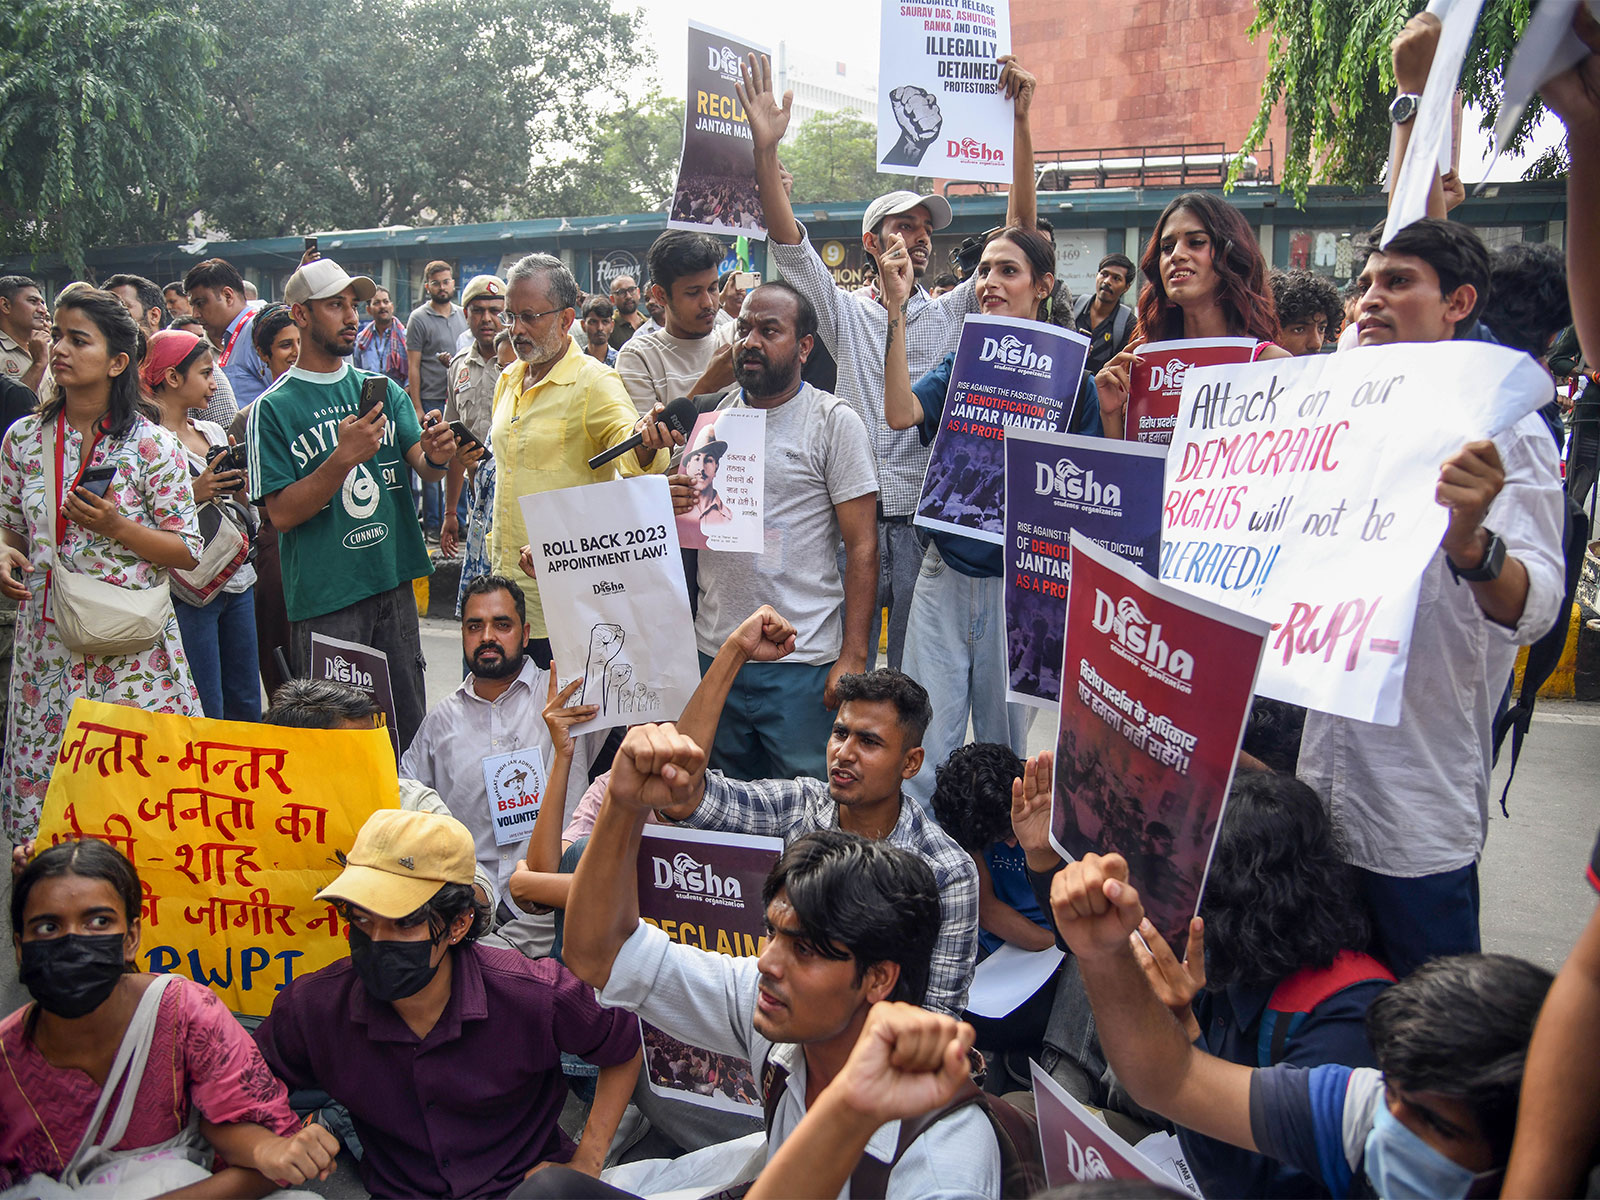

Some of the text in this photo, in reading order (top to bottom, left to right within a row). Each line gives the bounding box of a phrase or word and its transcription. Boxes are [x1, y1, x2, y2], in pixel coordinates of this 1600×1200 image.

[900, 0, 995, 16] IATELY RELEASE
[900, 6, 996, 27] SAURAV DAS, ASHUTOSH
[924, 20, 997, 39] RANKA AND OTHER
[926, 36, 997, 58] ILLEGALLY
[938, 61, 998, 80] DETAINED
[944, 81, 998, 95] PROTESTORS!
[697, 90, 750, 124] RECLA
[696, 118, 731, 135] JANTAR
[734, 124, 752, 140] MAN
[946, 137, 1003, 161] Disha
[827, 245, 839, 261] 9
[830, 269, 862, 283] HION
[978, 334, 1053, 371] Disha
[1018, 366, 1051, 379] organization
[1148, 358, 1195, 391] Dis
[954, 392, 1060, 421] OF DENOTIFICATION OF
[957, 381, 1063, 410] RISE AGAINST THE FASCIST DICTUM
[1189, 375, 1405, 429] Attack on our
[947, 420, 1004, 441] AS A PROTE
[951, 403, 1057, 433] JANTAR MANTAR
[290, 420, 396, 469] SLYTN
[1175, 420, 1349, 483] DEMOCRATIC
[383, 468, 397, 485] 91
[1034, 458, 1121, 507] Disha
[1053, 500, 1122, 517] students organization
[1165, 486, 1396, 541] RIGHTS will not be
[350, 526, 384, 545] CUNNING
[542, 525, 667, 557] ROLL BACK 2023
[1016, 536, 1070, 560] OF DENOTI
[1017, 522, 1031, 534] RISE
[1033, 525, 1062, 541] AGAINST
[1063, 530, 1071, 541] TH
[1111, 540, 1144, 557] DICTUM
[548, 544, 668, 573] APPOINTMENT LAW!
[1016, 552, 1071, 580] JANTAR
[1161, 540, 1281, 598] OLERATED!!
[593, 581, 624, 594] Disha
[1016, 574, 1030, 590] AS
[1032, 578, 1040, 592] A
[1092, 588, 1195, 680] Disha
[325, 655, 373, 686] Disha
[1110, 643, 1192, 694] students organization
[1080, 658, 1197, 752] विरोध प्रदर्शन के अधिकार
[1078, 680, 1189, 775] पर हमला नहीं सहेंगे!
[138, 787, 255, 841] जनता
[275, 803, 329, 843] का
[498, 793, 540, 811] BSJAY
[497, 809, 540, 827] VOLUNTEE
[652, 852, 742, 898] Disha
[184, 888, 297, 936] जागीर
[676, 893, 744, 909] students organization
[144, 945, 305, 992] RWPI
